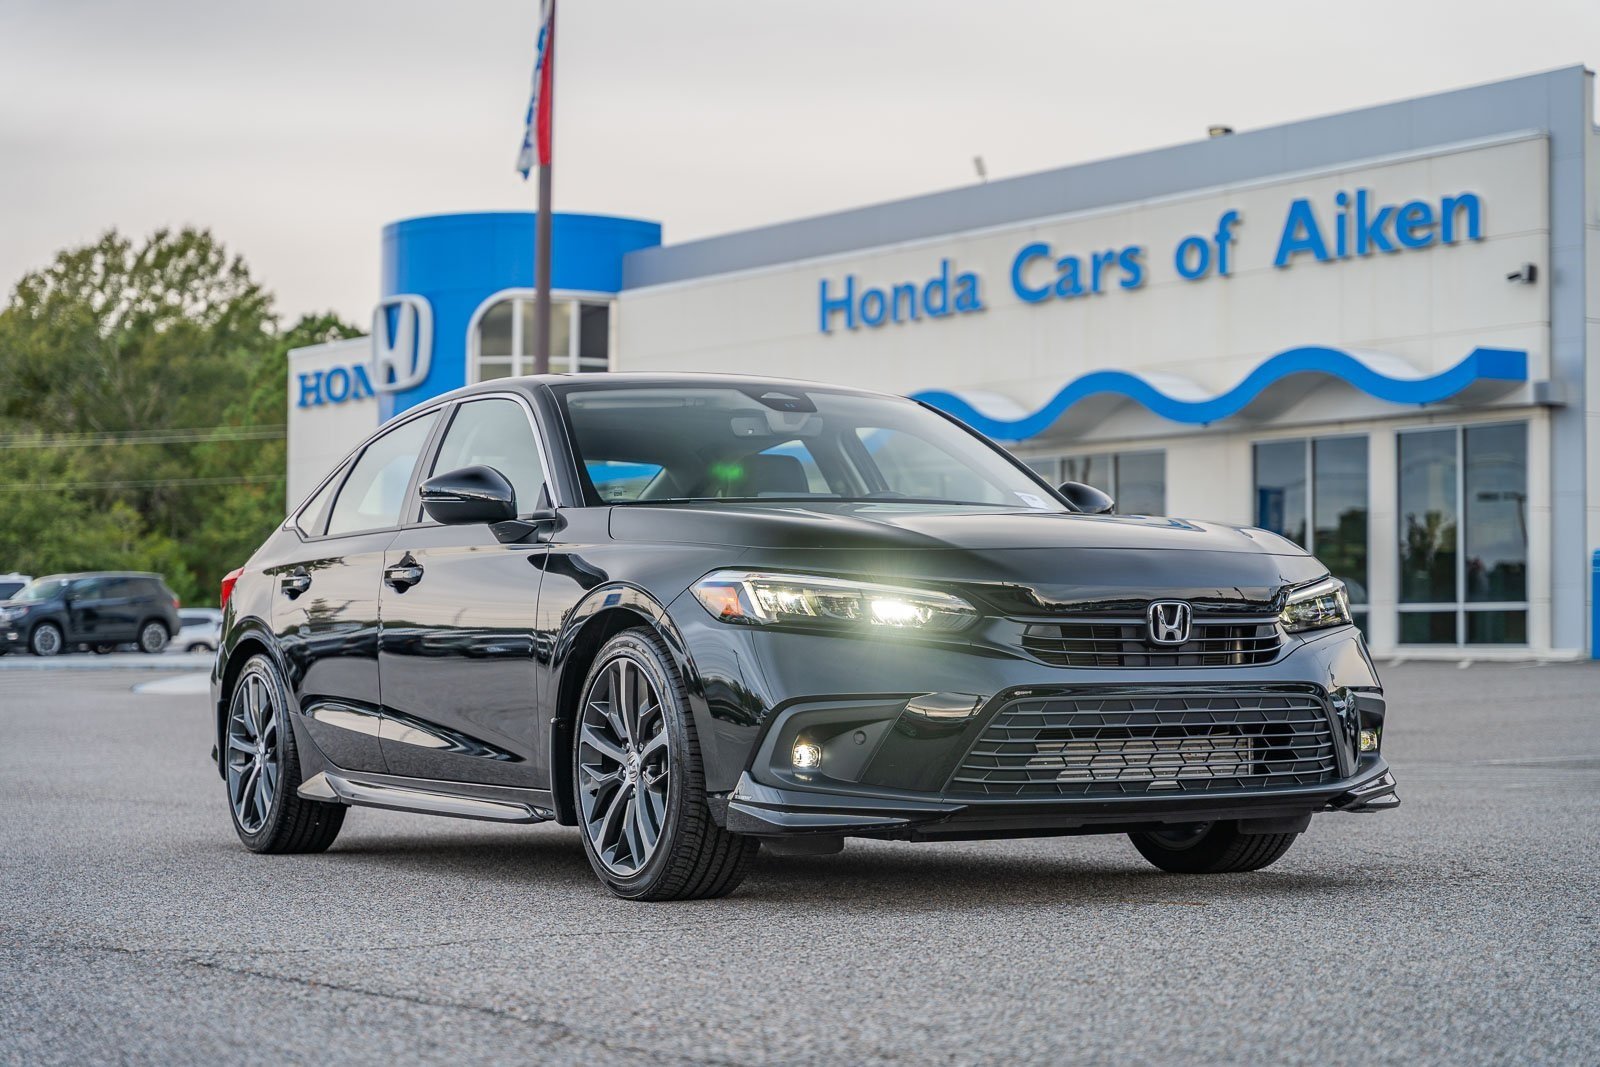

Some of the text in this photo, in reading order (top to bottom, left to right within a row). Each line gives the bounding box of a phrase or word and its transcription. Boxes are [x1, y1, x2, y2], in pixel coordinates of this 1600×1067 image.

[819, 188, 1482, 333] Honda Cars of Aiken
